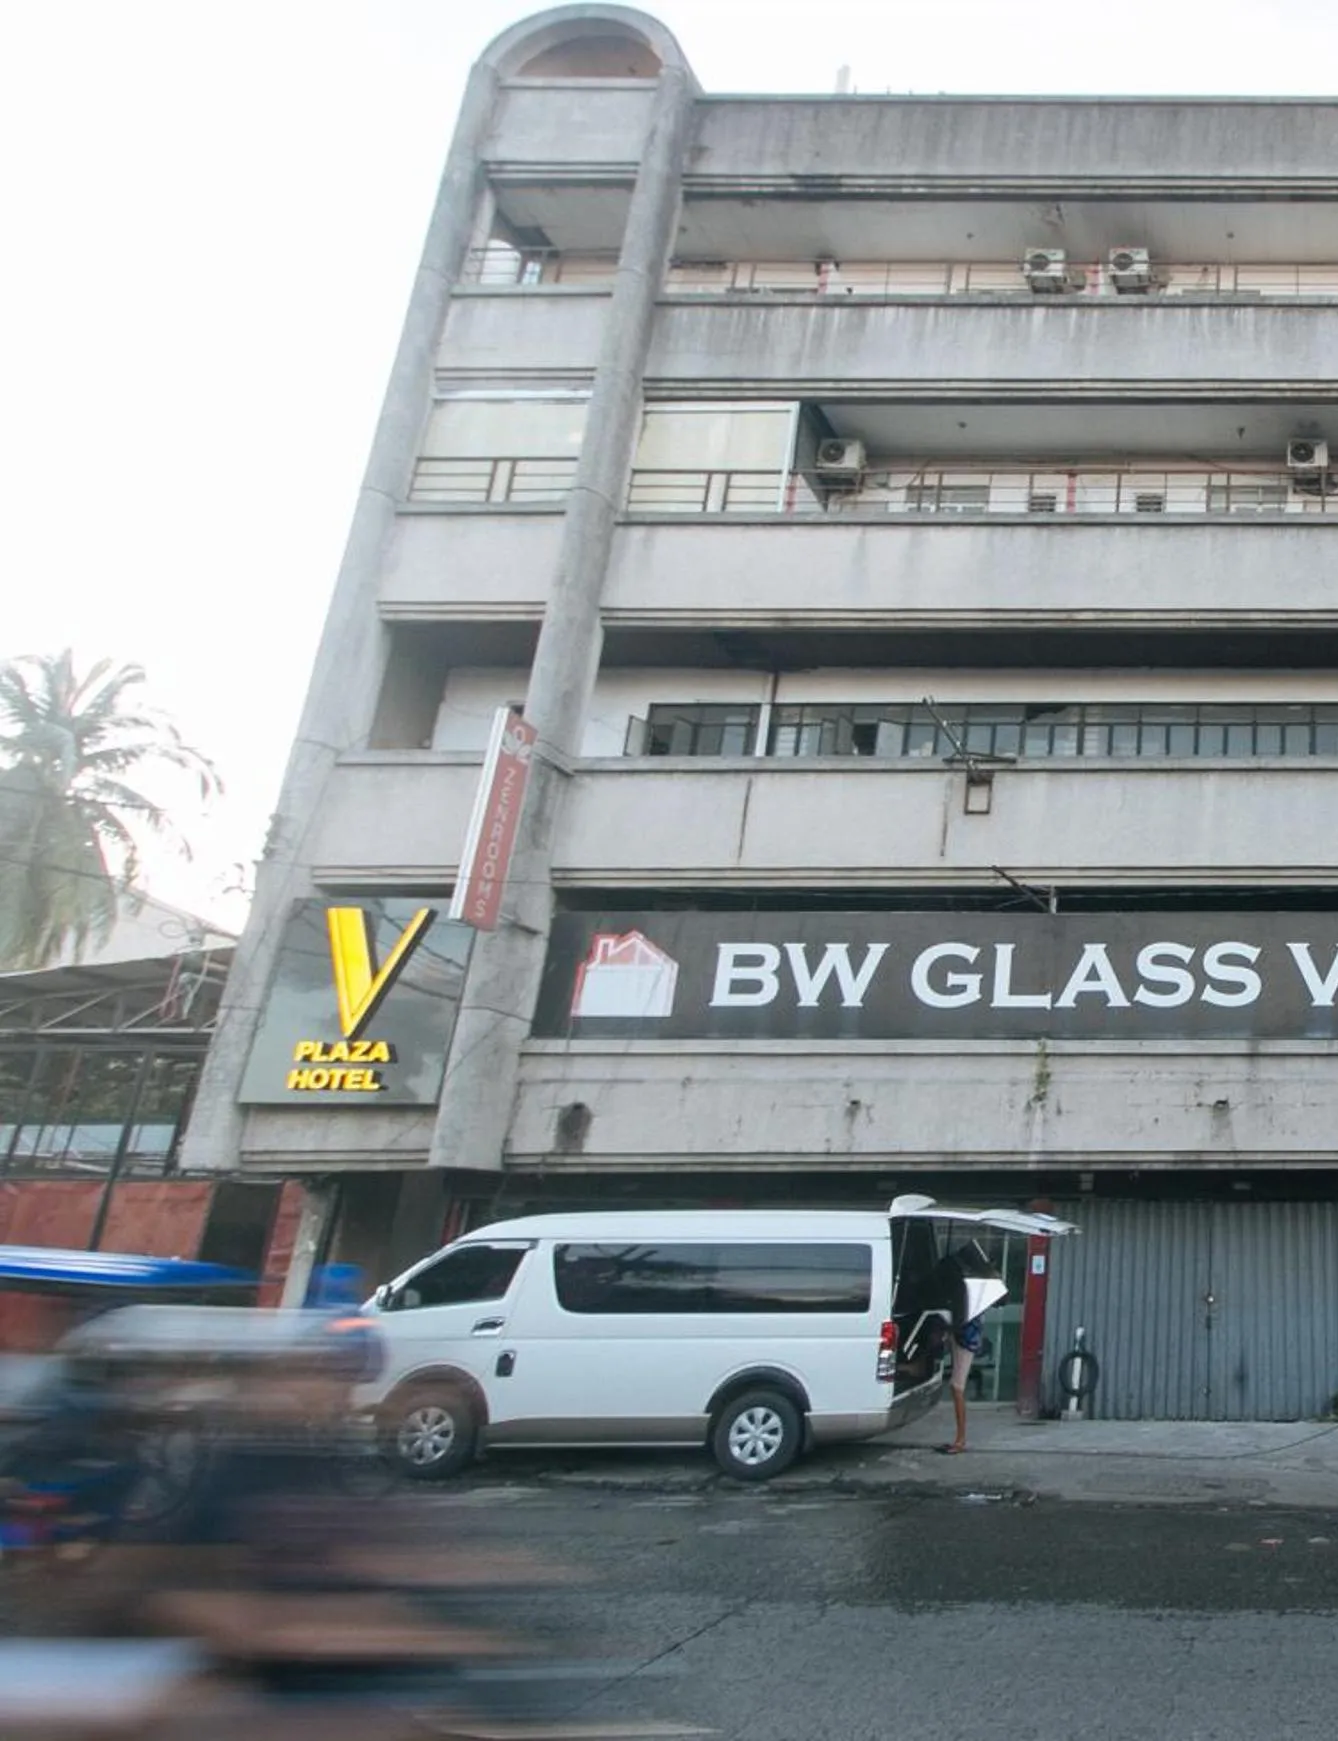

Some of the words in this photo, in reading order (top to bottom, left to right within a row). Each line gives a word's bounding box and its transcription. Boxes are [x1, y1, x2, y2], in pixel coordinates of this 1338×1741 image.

[327, 906, 430, 1039] V
[709, 942, 891, 1007] BW
[910, 941, 1262, 1009] GLASS
[294, 1040, 391, 1063] PLAZA
[287, 1068, 381, 1091] HOTEL
